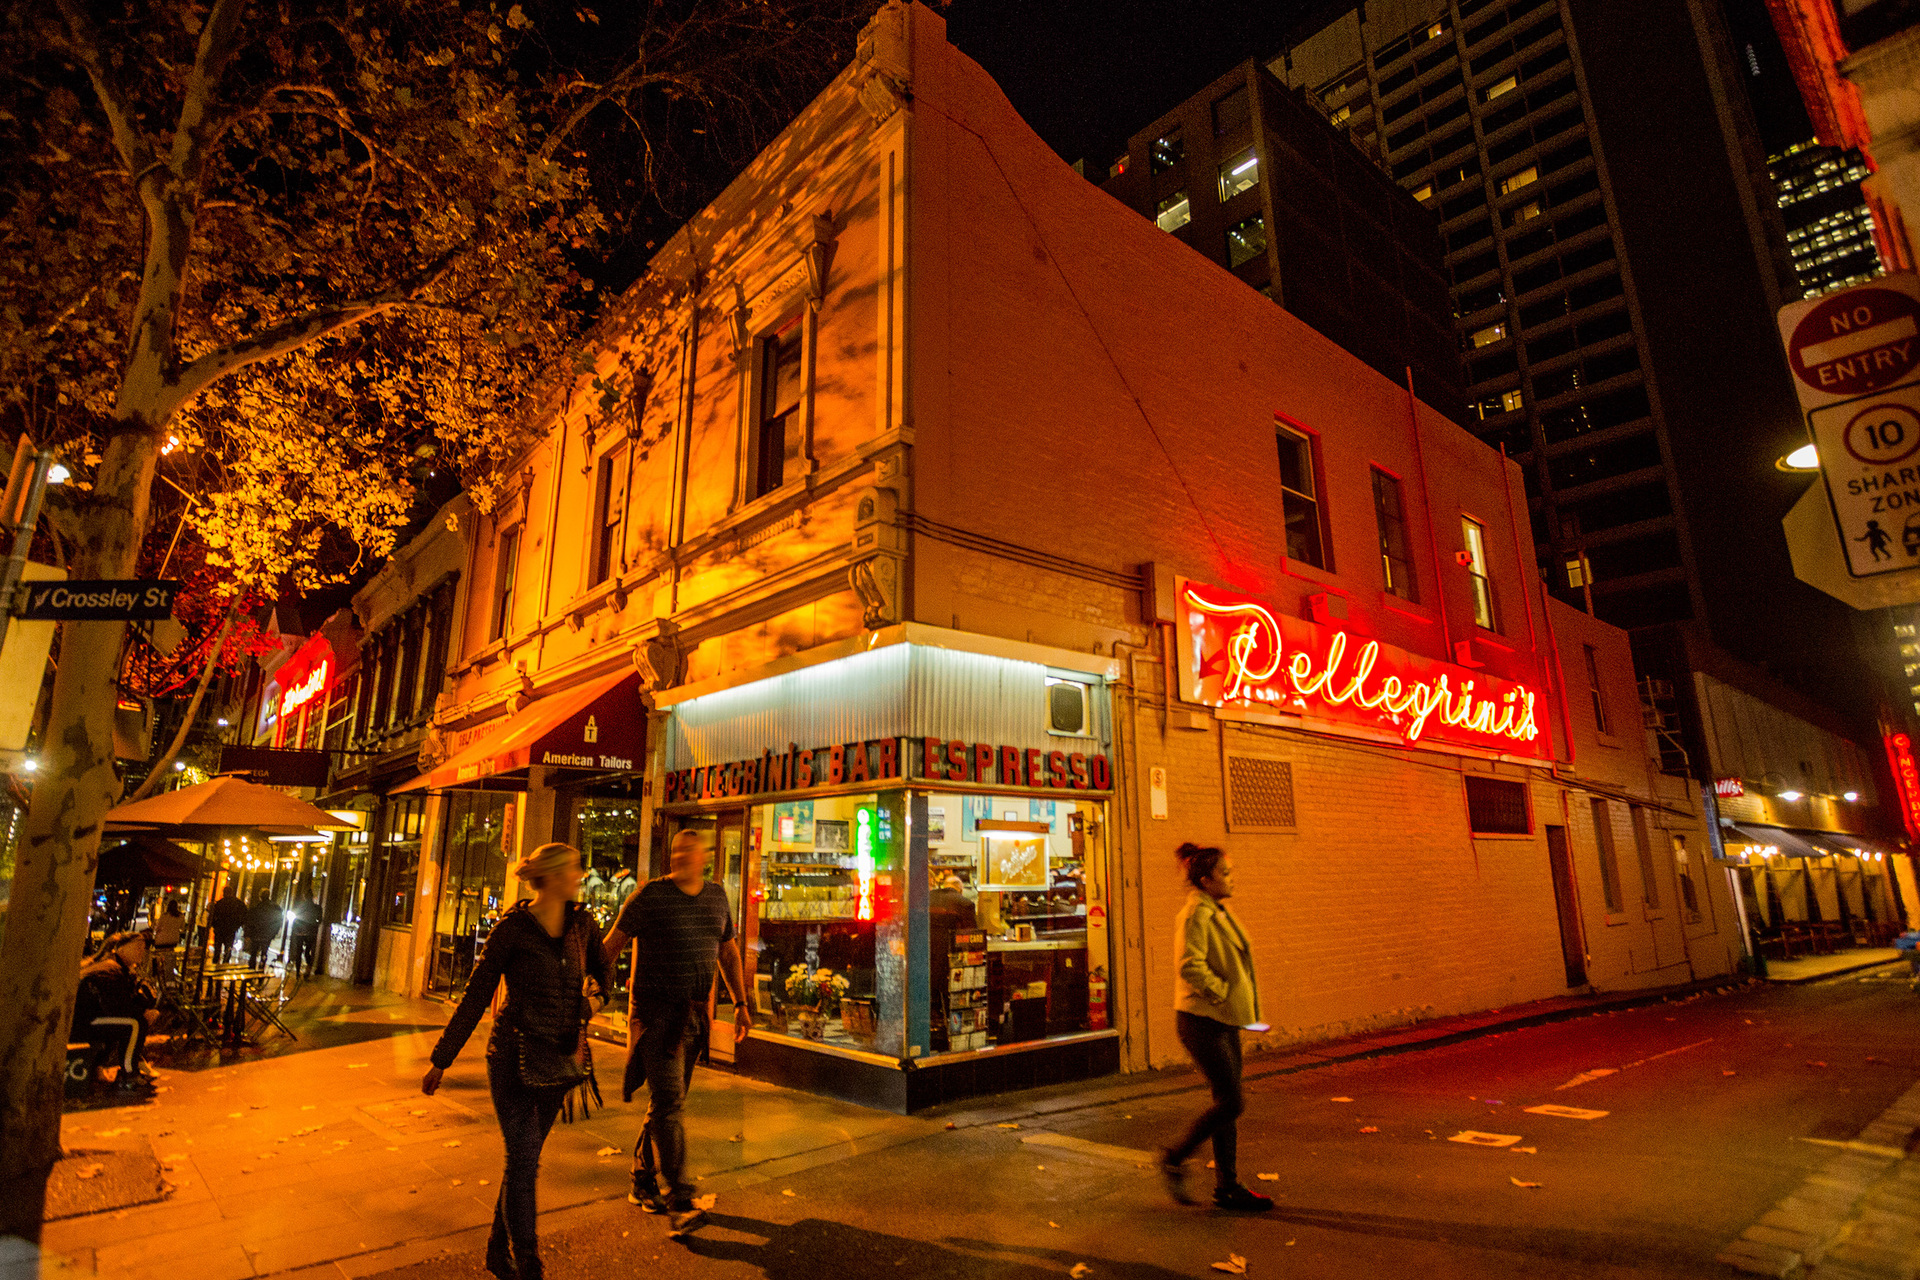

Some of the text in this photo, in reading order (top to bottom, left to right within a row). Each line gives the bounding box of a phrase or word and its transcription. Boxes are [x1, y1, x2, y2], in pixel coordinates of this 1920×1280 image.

[1830, 306, 1872, 334] NO
[1818, 341, 1911, 386] ENTRY
[1865, 420, 1905, 450] 10
[51, 586, 169, 612] Crossley St
[542, 750, 633, 770] American Tailors
[829, 737, 898, 786] BAR
[924, 736, 1110, 791] ESPRESSO
